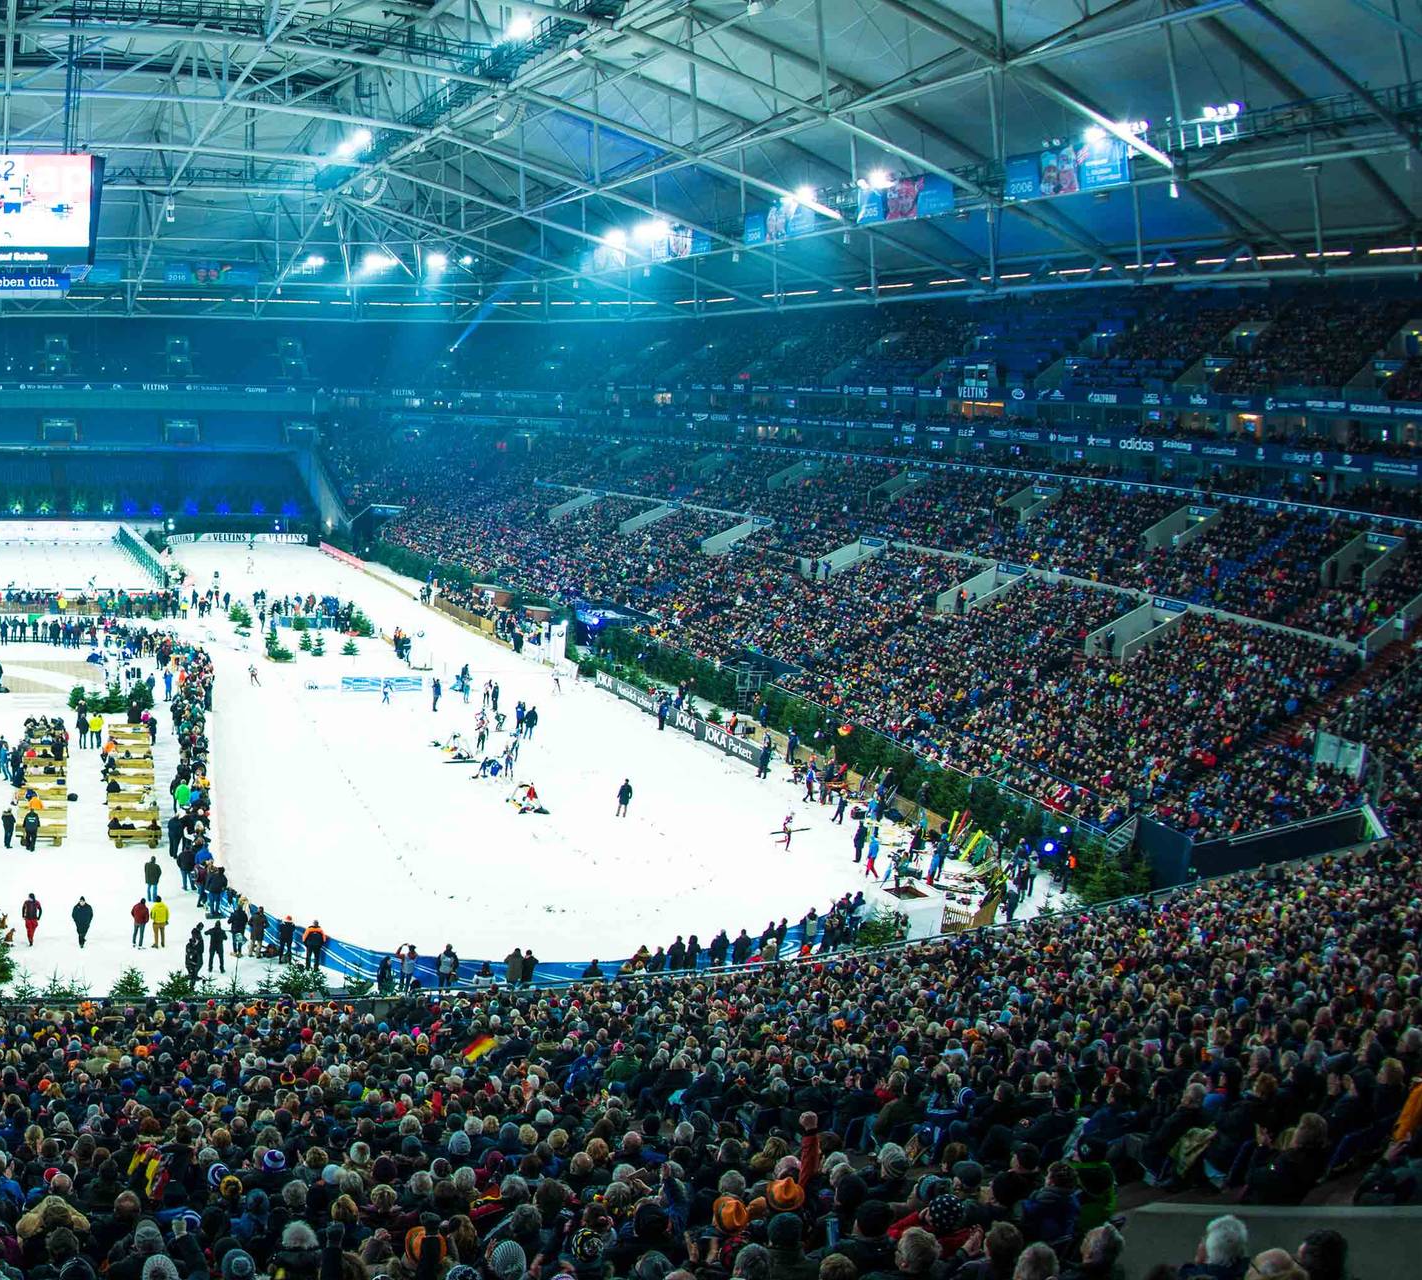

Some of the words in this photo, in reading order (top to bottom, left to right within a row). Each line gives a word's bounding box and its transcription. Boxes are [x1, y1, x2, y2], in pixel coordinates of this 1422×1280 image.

[13, 252, 48, 261] Schalke
[29, 276, 59, 288] dich.
[142, 383, 169, 391] VELTINS
[958, 386, 988, 399] VELTINS
[1119, 437, 1154, 452] adidas
[213, 534, 246, 542] VELTINS
[268, 534, 306, 543] VELTINS
[596, 671, 613, 690] JOKA
[675, 712, 696, 733] JOKA
[704, 726, 727, 748] JOKA
[728, 738, 753, 760] Parkett
